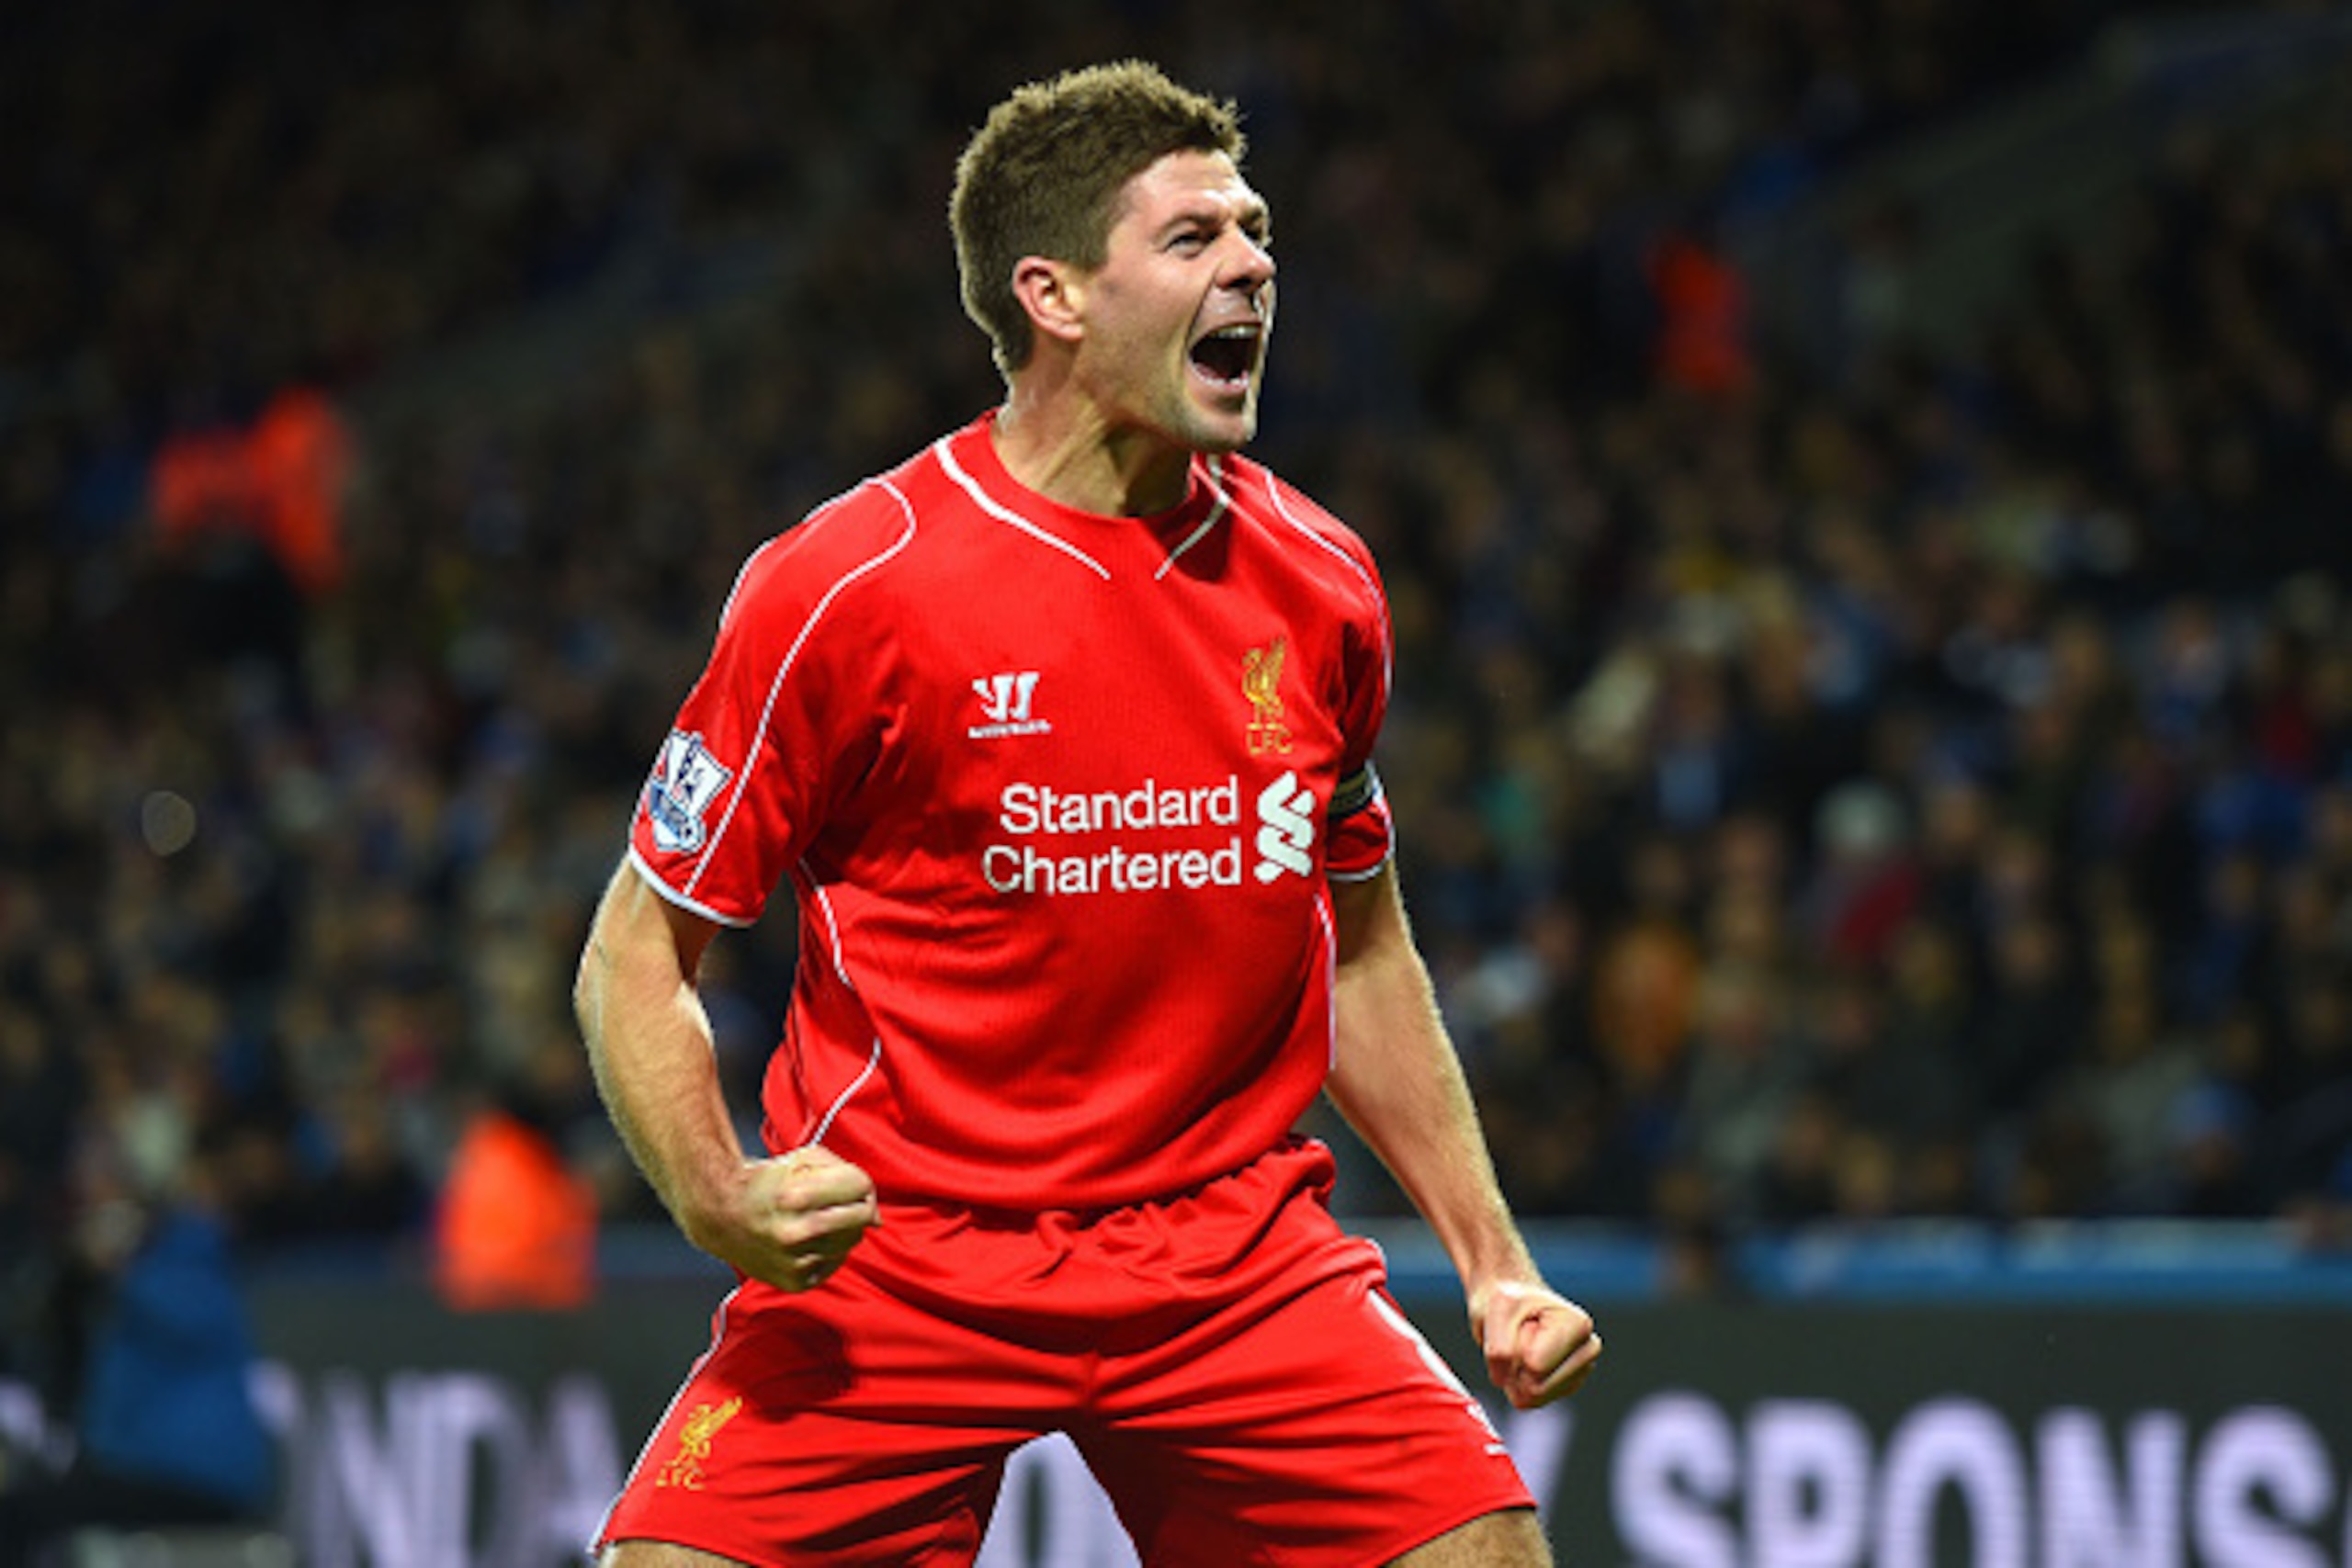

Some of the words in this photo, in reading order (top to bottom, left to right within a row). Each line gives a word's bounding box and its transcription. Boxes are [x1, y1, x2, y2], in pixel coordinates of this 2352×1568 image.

[1246, 728, 1294, 755] LFC
[1000, 774, 1239, 834] Standard
[982, 837, 1242, 897] Chartered
[656, 1467, 706, 1490] LFC
[1610, 1389, 2352, 1568] SPONS
